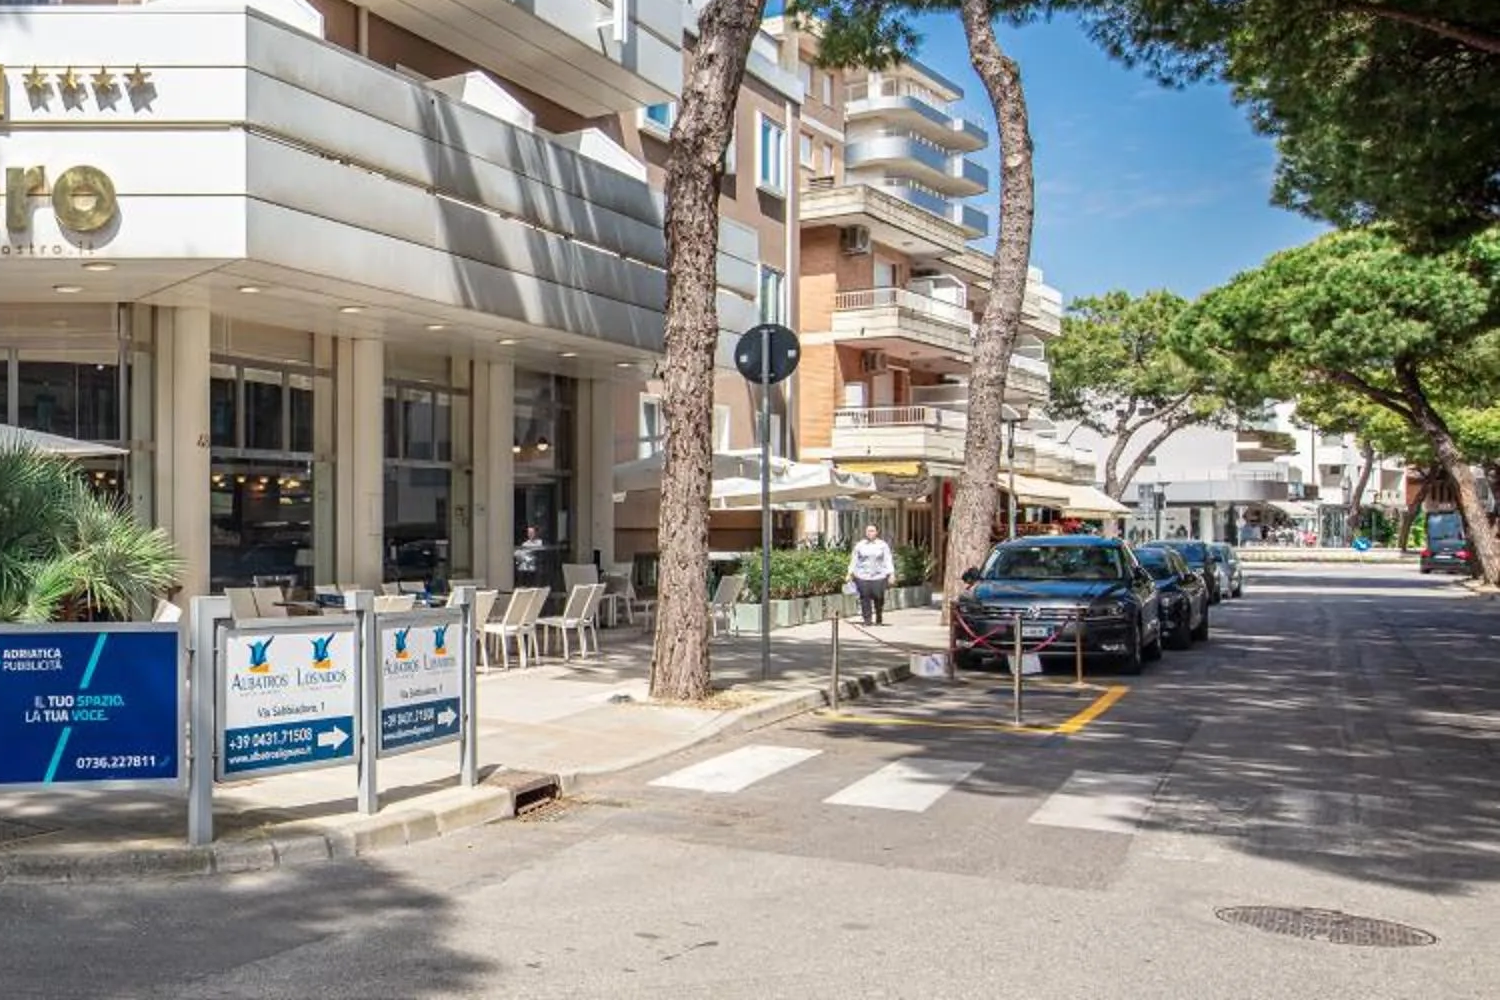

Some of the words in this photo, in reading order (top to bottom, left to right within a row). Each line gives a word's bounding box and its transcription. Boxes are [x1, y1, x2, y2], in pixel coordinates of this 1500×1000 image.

[3, 648, 62, 659] ADRIATICA
[232, 673, 289, 690] ALBATROS
[34, 695, 46, 708] IL
[48, 695, 75, 707] TUO
[25, 711, 41, 723] LA
[43, 709, 69, 722] TUA
[229, 735, 250, 750] +39
[76, 756, 156, 769] 0736.227811
